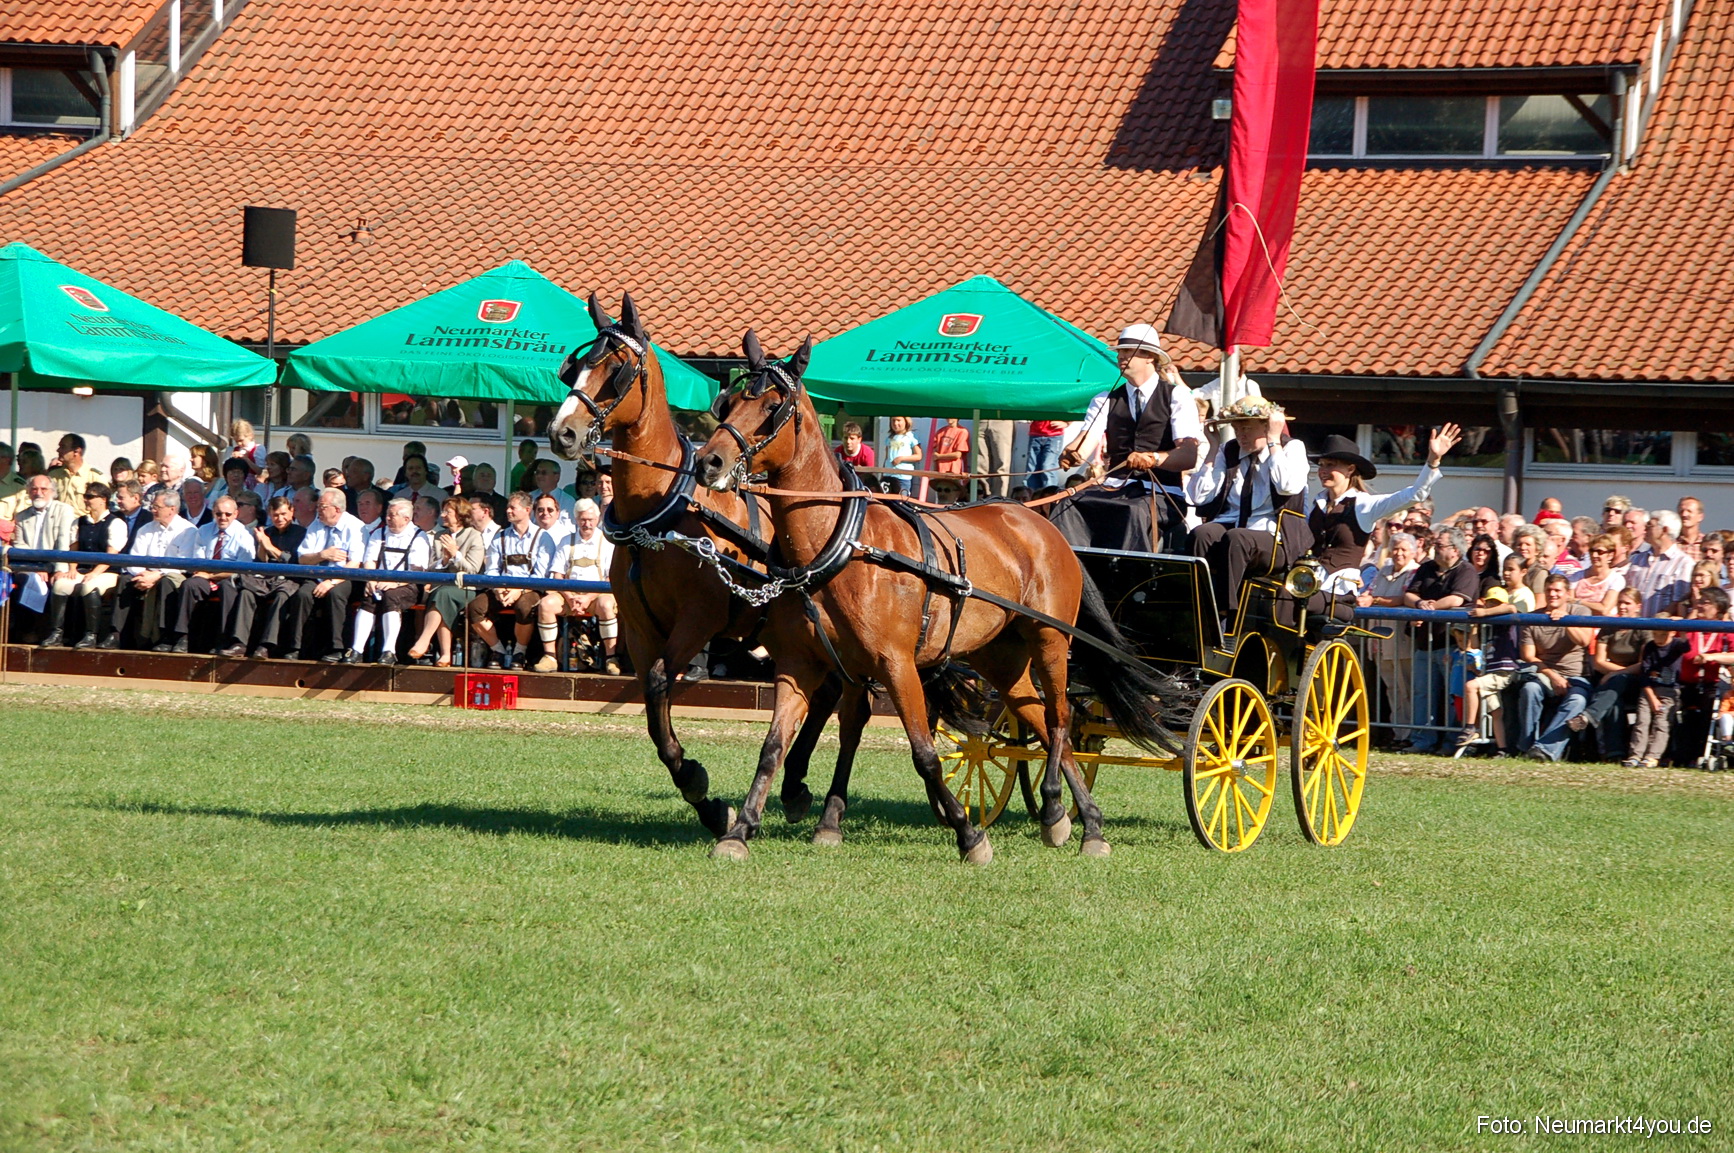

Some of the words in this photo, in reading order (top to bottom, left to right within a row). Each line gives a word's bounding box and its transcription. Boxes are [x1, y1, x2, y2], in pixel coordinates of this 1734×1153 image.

[433, 325, 550, 341] Neumarkter
[405, 333, 567, 354] Lammsbräu
[894, 340, 1012, 353] Neumarkter
[866, 349, 1028, 366] Lammsbräu
